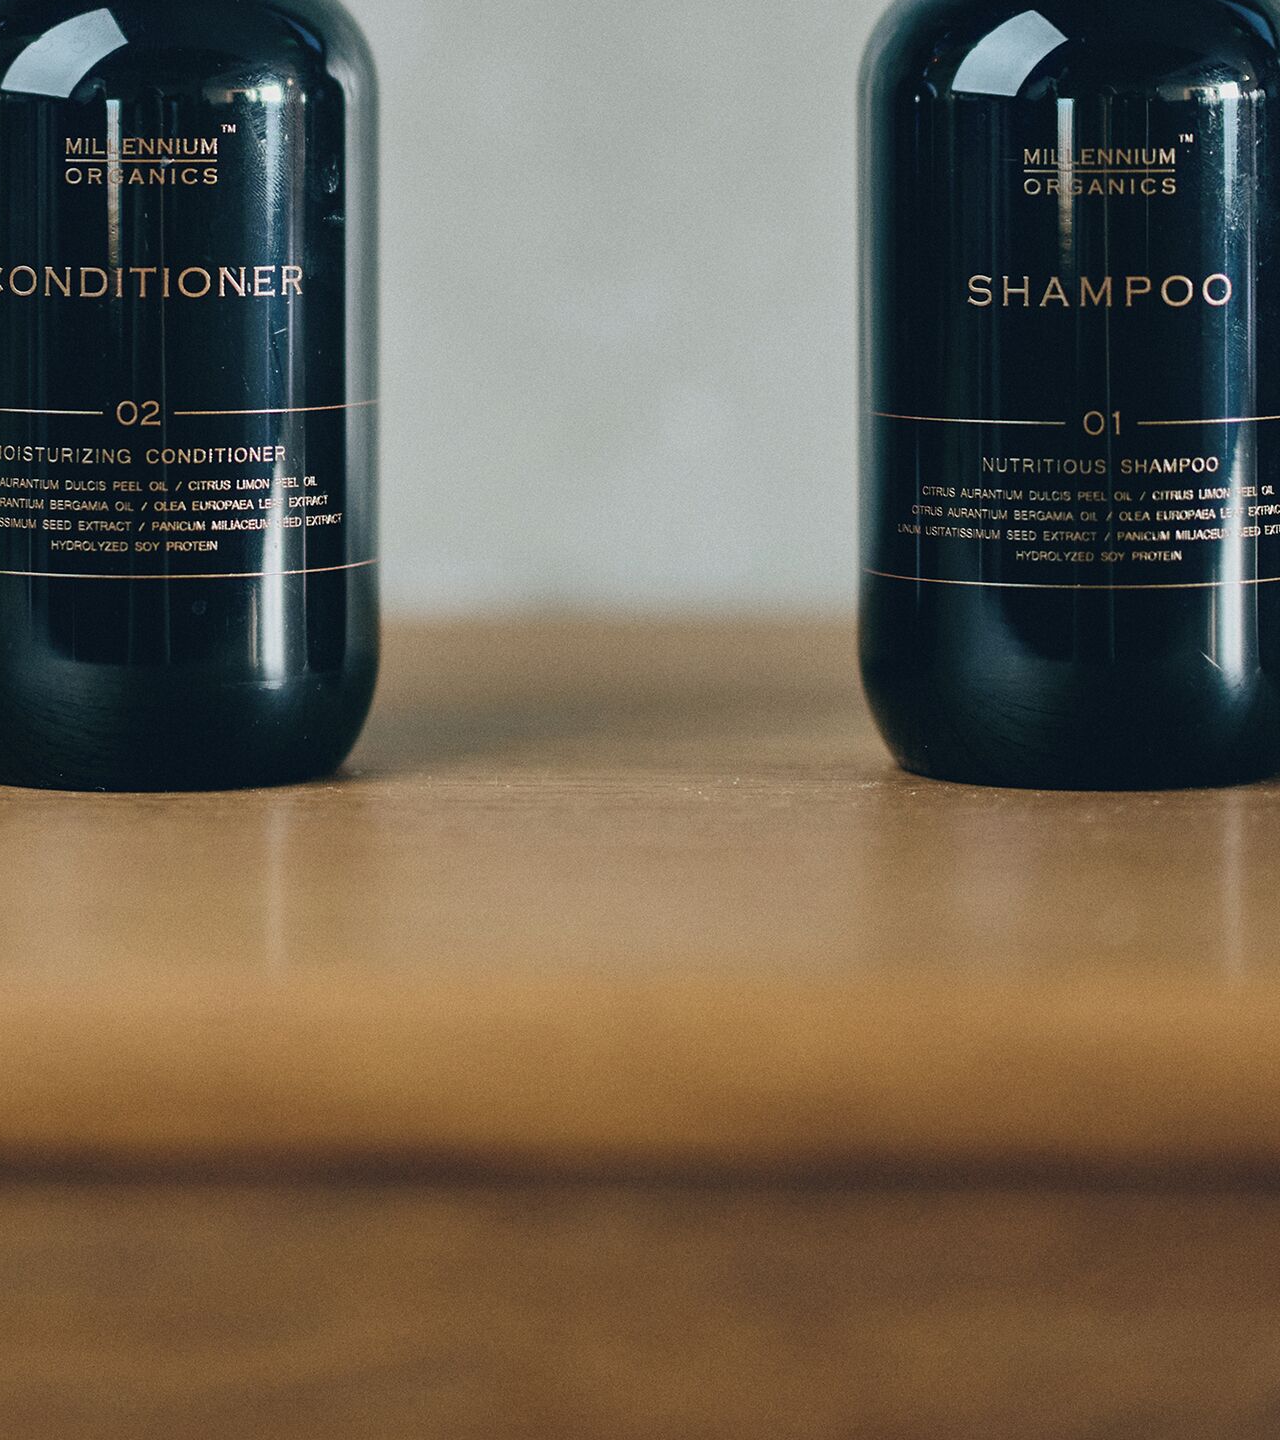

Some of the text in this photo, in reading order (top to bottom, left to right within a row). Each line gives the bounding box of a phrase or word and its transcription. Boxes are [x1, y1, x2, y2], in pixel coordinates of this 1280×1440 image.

[65, 137, 218, 155] MILLENNIUM
[1024, 148, 1176, 165] MILLENNIUM
[65, 167, 218, 185] ORGANICS
[1024, 178, 1176, 195] ORGANICS
[968, 273, 1232, 307] SHAMPOO
[116, 400, 161, 426] 02
[1083, 410, 1121, 436] 01
[146, 445, 286, 464] CONDITIONER
[982, 456, 1219, 474] NUTRITIOUS SHAMPOO
[0, 477, 59, 490] AURANTIUM
[65, 480, 106, 491] DULCIS
[113, 481, 142, 491] PEEL
[149, 481, 168, 491] OIL
[188, 480, 231, 491] CITRUS
[236, 478, 270, 490] LIMON
[303, 476, 318, 487] OIL
[922, 486, 956, 498] CITRUS
[960, 488, 1022, 500] AURANTIUM
[1029, 490, 1071, 501] DULCIS
[1078, 491, 1107, 501] PEEL
[1114, 491, 1132, 501] OIL
[1152, 489, 1194, 501] CITRUS
[50, 499, 109, 511] BERGAMIA
[115, 501, 134, 511] OIL
[154, 500, 187, 511] OLEA
[192, 499, 254, 510] EUROPAEA
[288, 495, 328, 507] EXTRACT
[911, 505, 943, 516] CITRUS
[948, 507, 1008, 520] AURANTIUM
[1014, 510, 1073, 521] BERGAMIA
[1080, 512, 1098, 522] OIL
[1119, 511, 1151, 522] OLEA
[1156, 509, 1216, 521] EUROPAEA
[42, 519, 72, 531] SEED
[78, 521, 131, 532] EXTRACT
[152, 521, 206, 532] PANICUM
[306, 513, 343, 526] EXTRACT
[925, 526, 1001, 540] USITATISSIMUM
[1006, 530, 1037, 541] SEED
[1043, 531, 1096, 541] EXTRACT
[1117, 530, 1170, 541] PANICUM
[51, 540, 218, 552] HYDROLYZED SOY PROTEIN
[1016, 550, 1183, 562] HYDROLYZED SOY PROTEIN
